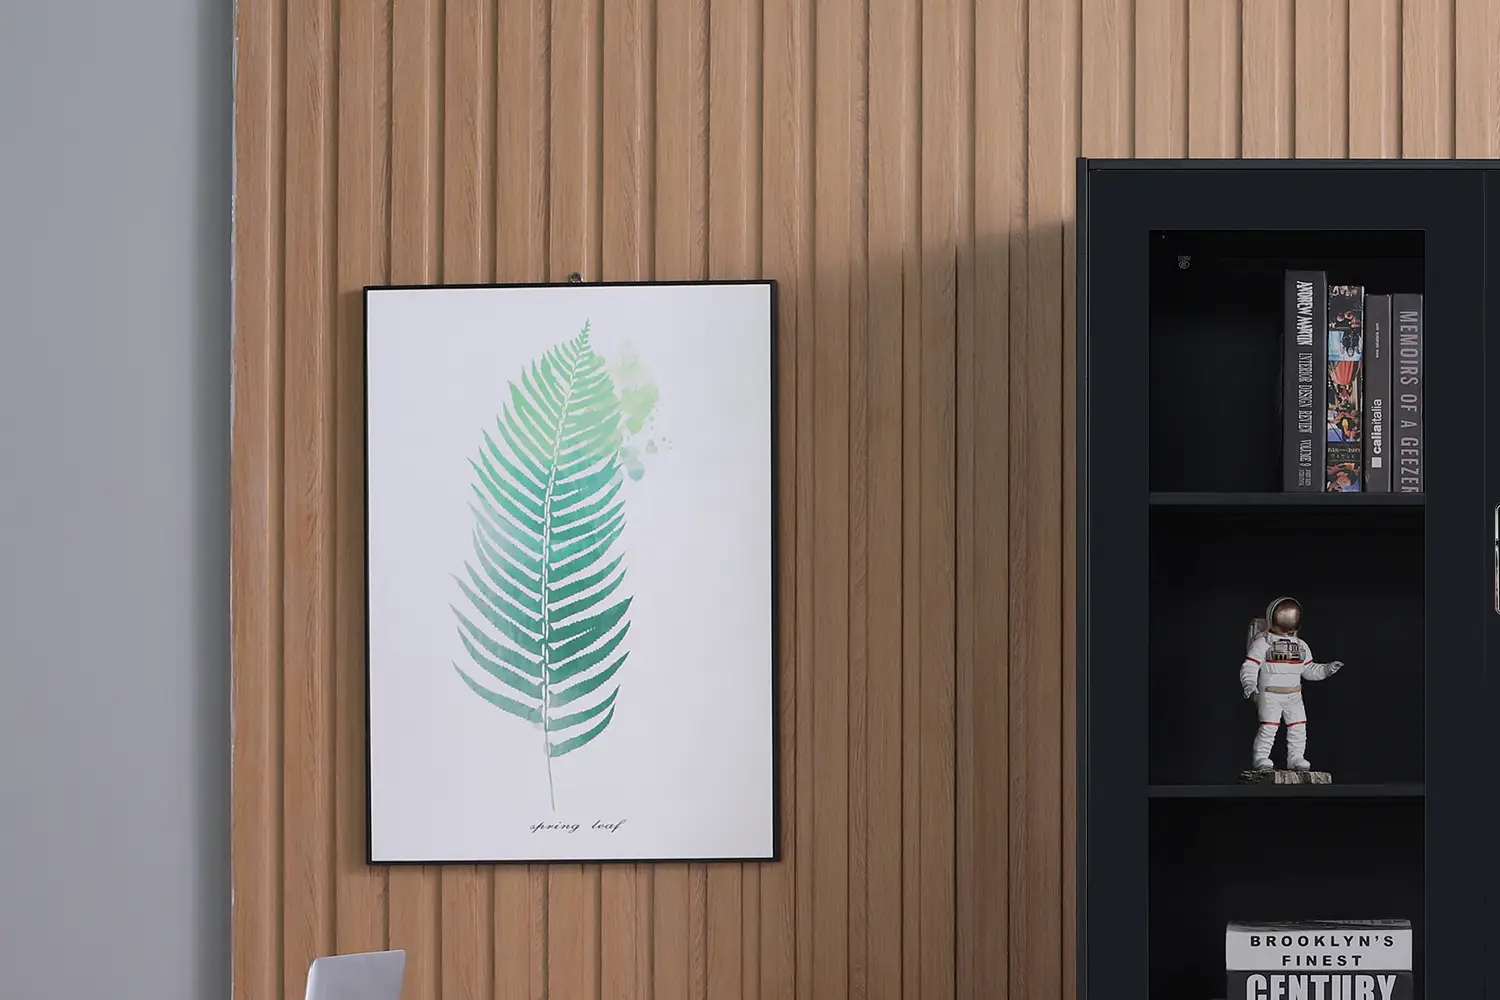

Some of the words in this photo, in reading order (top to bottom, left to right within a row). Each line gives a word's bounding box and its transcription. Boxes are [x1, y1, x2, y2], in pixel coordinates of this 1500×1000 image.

[1296, 280, 1313, 316] ANDREW
[1296, 315, 1313, 346] MARTIN
[1400, 311, 1418, 385] MEMOIRS
[1298, 352, 1313, 383] INTERIOR
[1298, 384, 1313, 408] DESIGN
[1400, 394, 1417, 413] OF
[1298, 410, 1313, 434] REVIEW
[1371, 398, 1383, 455] caliaitalia
[1400, 420, 1417, 429] A
[1299, 439, 1312, 462] VOLUME
[1400, 436, 1419, 492] GEEZER
[529, 821, 581, 834] spring
[591, 819, 628, 834] leaf
[1249, 935, 1395, 947] BROOKLYN'S
[1281, 954, 1363, 967] FINEST
